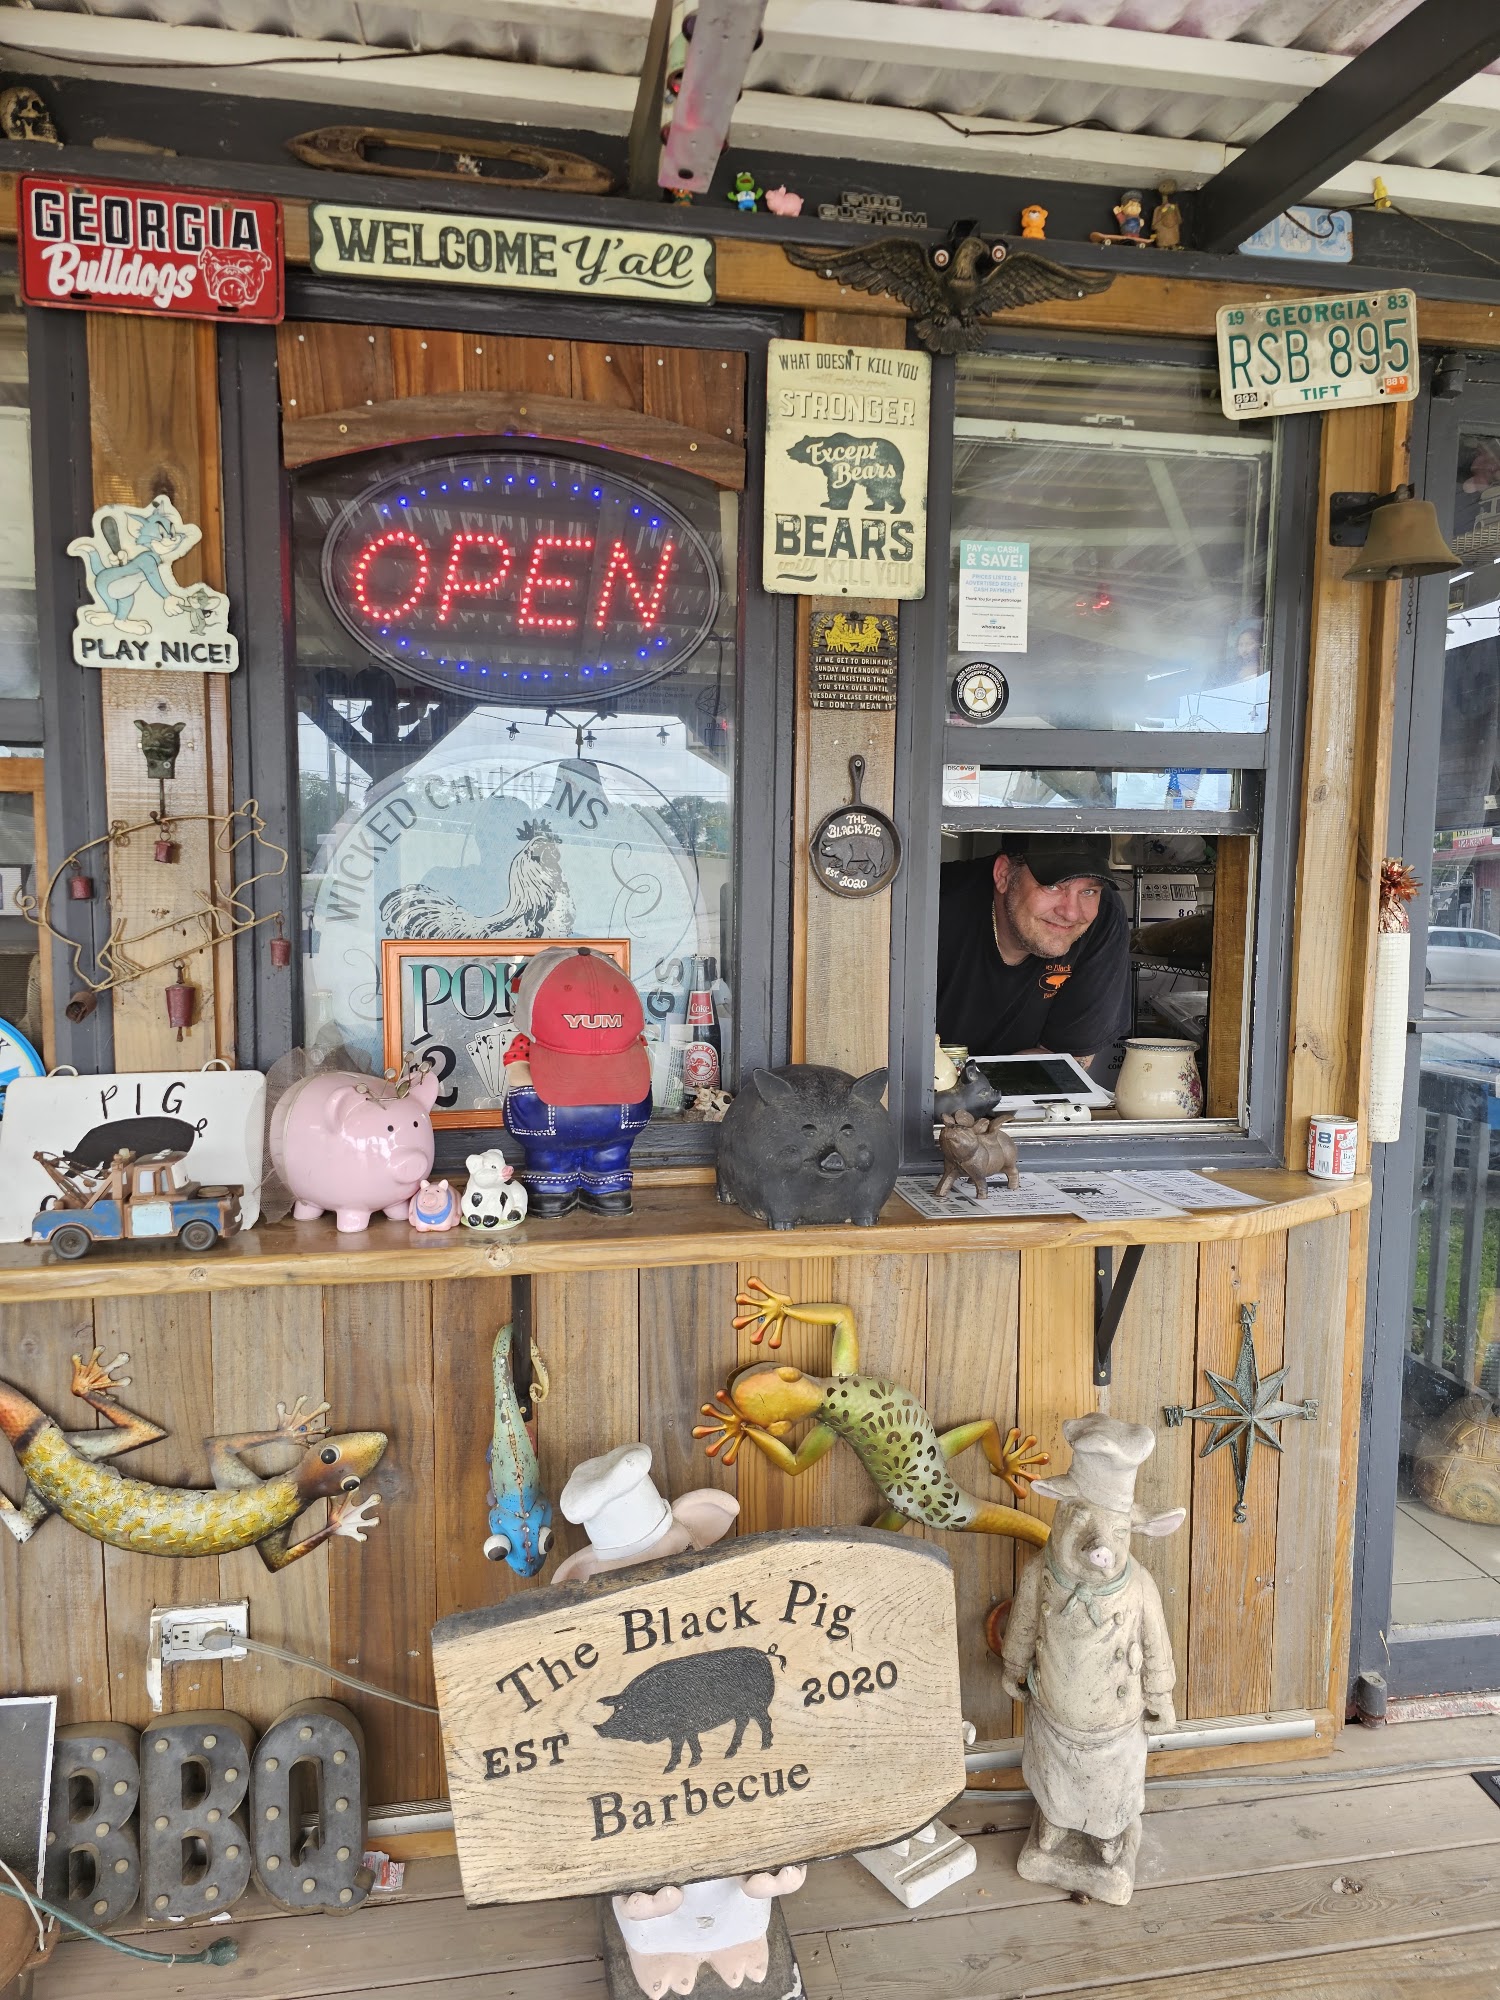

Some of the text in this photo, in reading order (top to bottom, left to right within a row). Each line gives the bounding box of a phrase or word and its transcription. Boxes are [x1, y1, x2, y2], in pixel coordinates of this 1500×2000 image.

[31, 188, 262, 255] GEORGIA
[818, 203, 928, 229] CUSTOM
[329, 216, 694, 287] WELCOME Y'all
[41, 243, 197, 308] Bulldogs
[1227, 294, 1409, 327] 19 GEORGIA 83
[779, 353, 919, 381] WHAT DOESN'T KILL YOU
[1229, 318, 1409, 389] RSB 895
[779, 388, 916, 426] STRONGER
[1300, 385, 1342, 401] TIFT
[805, 441, 879, 466] Except
[831, 462, 897, 489] Bears
[774, 513, 915, 562] BEARS
[966, 544, 983, 553] PAY
[997, 545, 1019, 554] CASH
[776, 559, 913, 588] will KILL YOU
[966, 552, 1023, 568] & SAVE!
[355, 531, 675, 630] OPEN
[812, 614, 897, 648] WEEKEND GUEST
[80, 637, 233, 665] PLAY NICE!
[861, 658, 893, 666] DRINKING
[841, 666, 879, 674] AFTERNOON
[829, 701, 854, 709] DON'T
[860, 702, 881, 710] MEAN
[864, 694, 897, 702] REMEMBER
[826, 823, 882, 839] BLACK PIG
[846, 814, 868, 825] THE
[325, 798, 418, 927] WICKED
[839, 876, 868, 889] 2020
[408, 961, 532, 1046] POK
[691, 1002, 710, 1013] Coke
[561, 1013, 624, 1030] YUM
[100, 1081, 186, 1120] PIG
[1318, 1131, 1332, 1144] 8
[1302, 1398, 1320, 1421] E
[1232, 1501, 1248, 1524] S
[496, 1578, 856, 1714] The Black Pig
[800, 1660, 899, 1709] 2020
[482, 1733, 571, 1782] EST
[46, 1698, 376, 1934] BBQ
[586, 1763, 812, 1842] Barbecue
